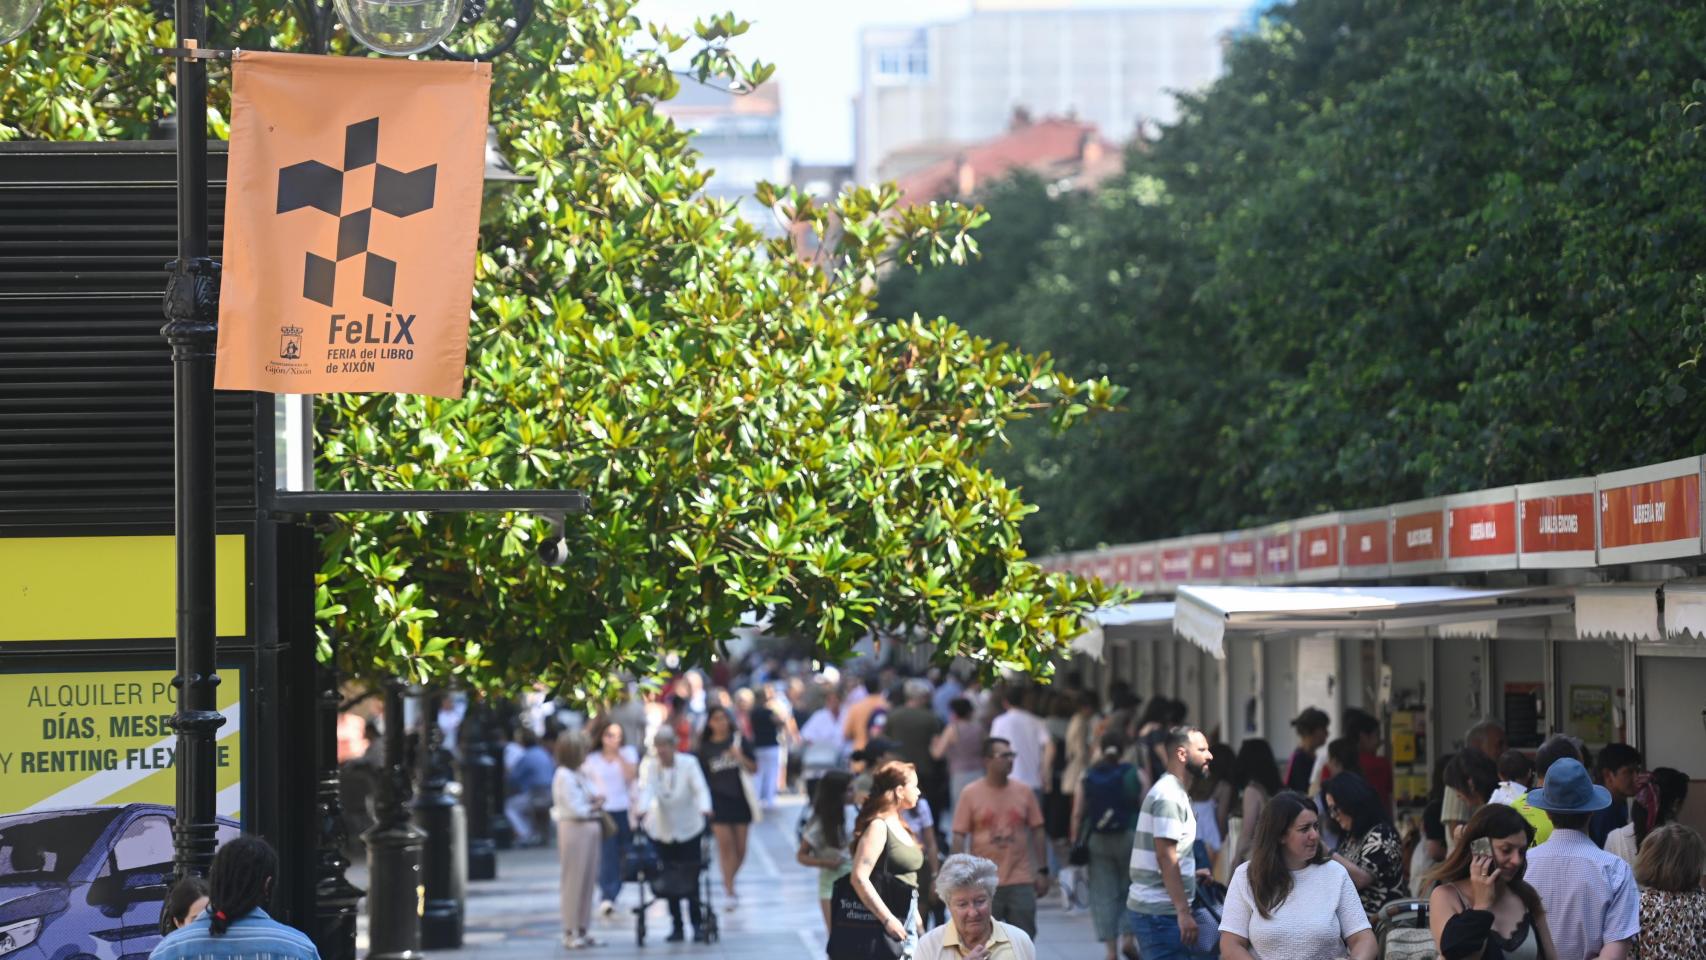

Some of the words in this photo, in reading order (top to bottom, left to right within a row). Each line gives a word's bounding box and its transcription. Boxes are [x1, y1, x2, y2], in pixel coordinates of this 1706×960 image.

[329, 313, 416, 345] FeLiX
[326, 363, 338, 373] de
[342, 360, 375, 373] XIXÓN
[328, 349, 357, 360] FERIA
[360, 349, 376, 359] del
[381, 349, 413, 360] LIBRO
[28, 683, 142, 707] ALQUILER
[152, 682, 177, 704] PO
[43, 712, 100, 741] DÍAS,
[0, 753, 12, 774] Y
[21, 749, 118, 773] RENTING
